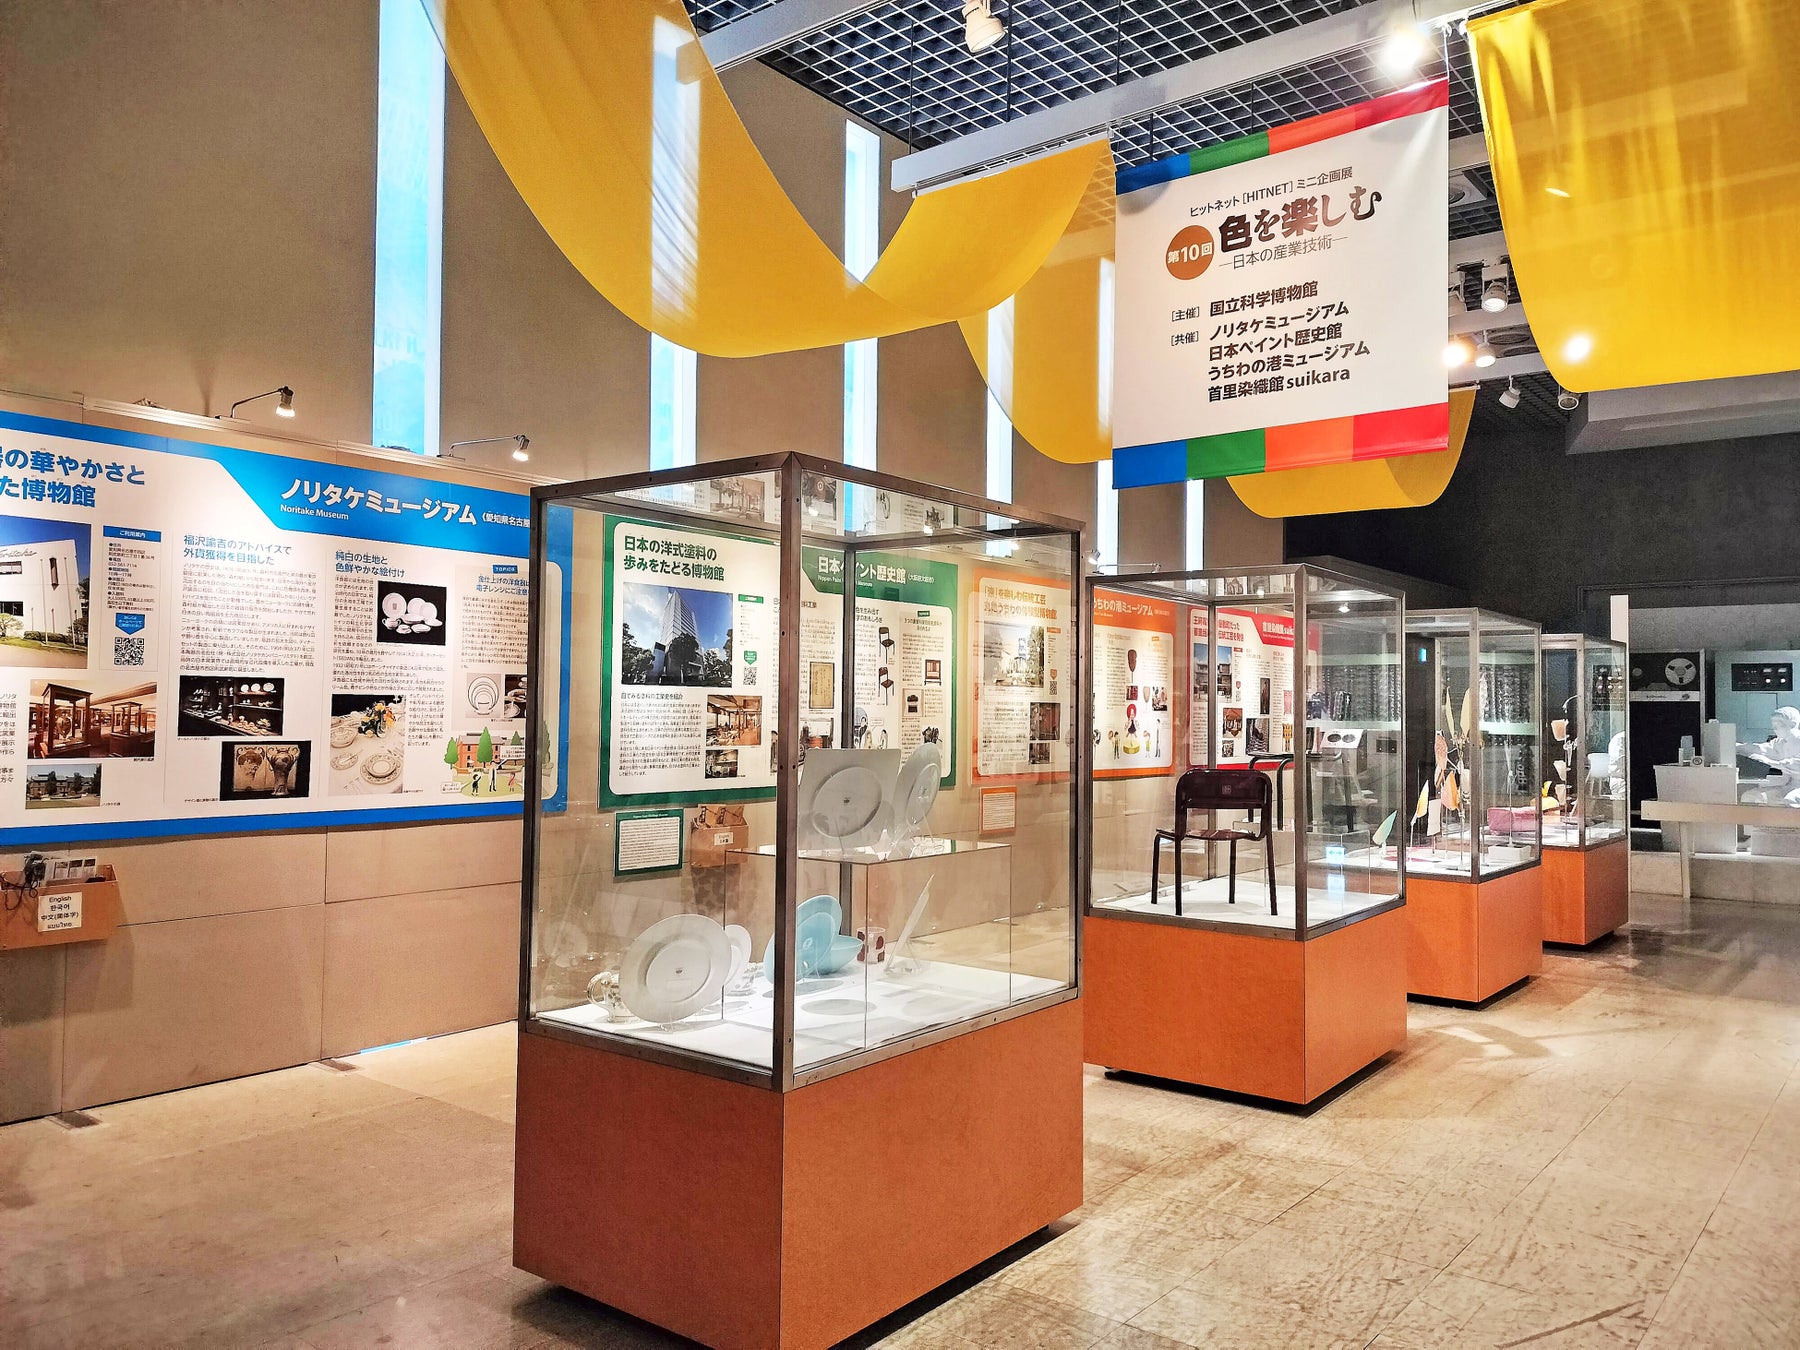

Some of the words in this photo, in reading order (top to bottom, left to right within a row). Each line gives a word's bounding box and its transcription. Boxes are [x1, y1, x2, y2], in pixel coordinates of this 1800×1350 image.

[1218, 185, 1382, 253] 色を楽しむ
[1167, 241, 1213, 265] 第10回
[1210, 281, 1318, 317] 国立科学博物館
[1210, 301, 1350, 341] ノリタケミュージアム
[1209, 323, 1342, 361] 日本ペイント歴史館
[1208, 341, 1371, 381] うちわの港ミュージアム
[280, 504, 315, 517] Noritake
[315, 508, 349, 521] Museum
[281, 478, 477, 526] ノリタケミュージアム
[183, 547, 275, 565] 外貨獲得を目指した
[335, 550, 388, 565] 純白の生地と
[624, 535, 717, 561] 日本の洋式塗料の
[335, 562, 405, 578] 色鮮やかな絵付け
[623, 555, 725, 581] 歩みをたどる博物館
